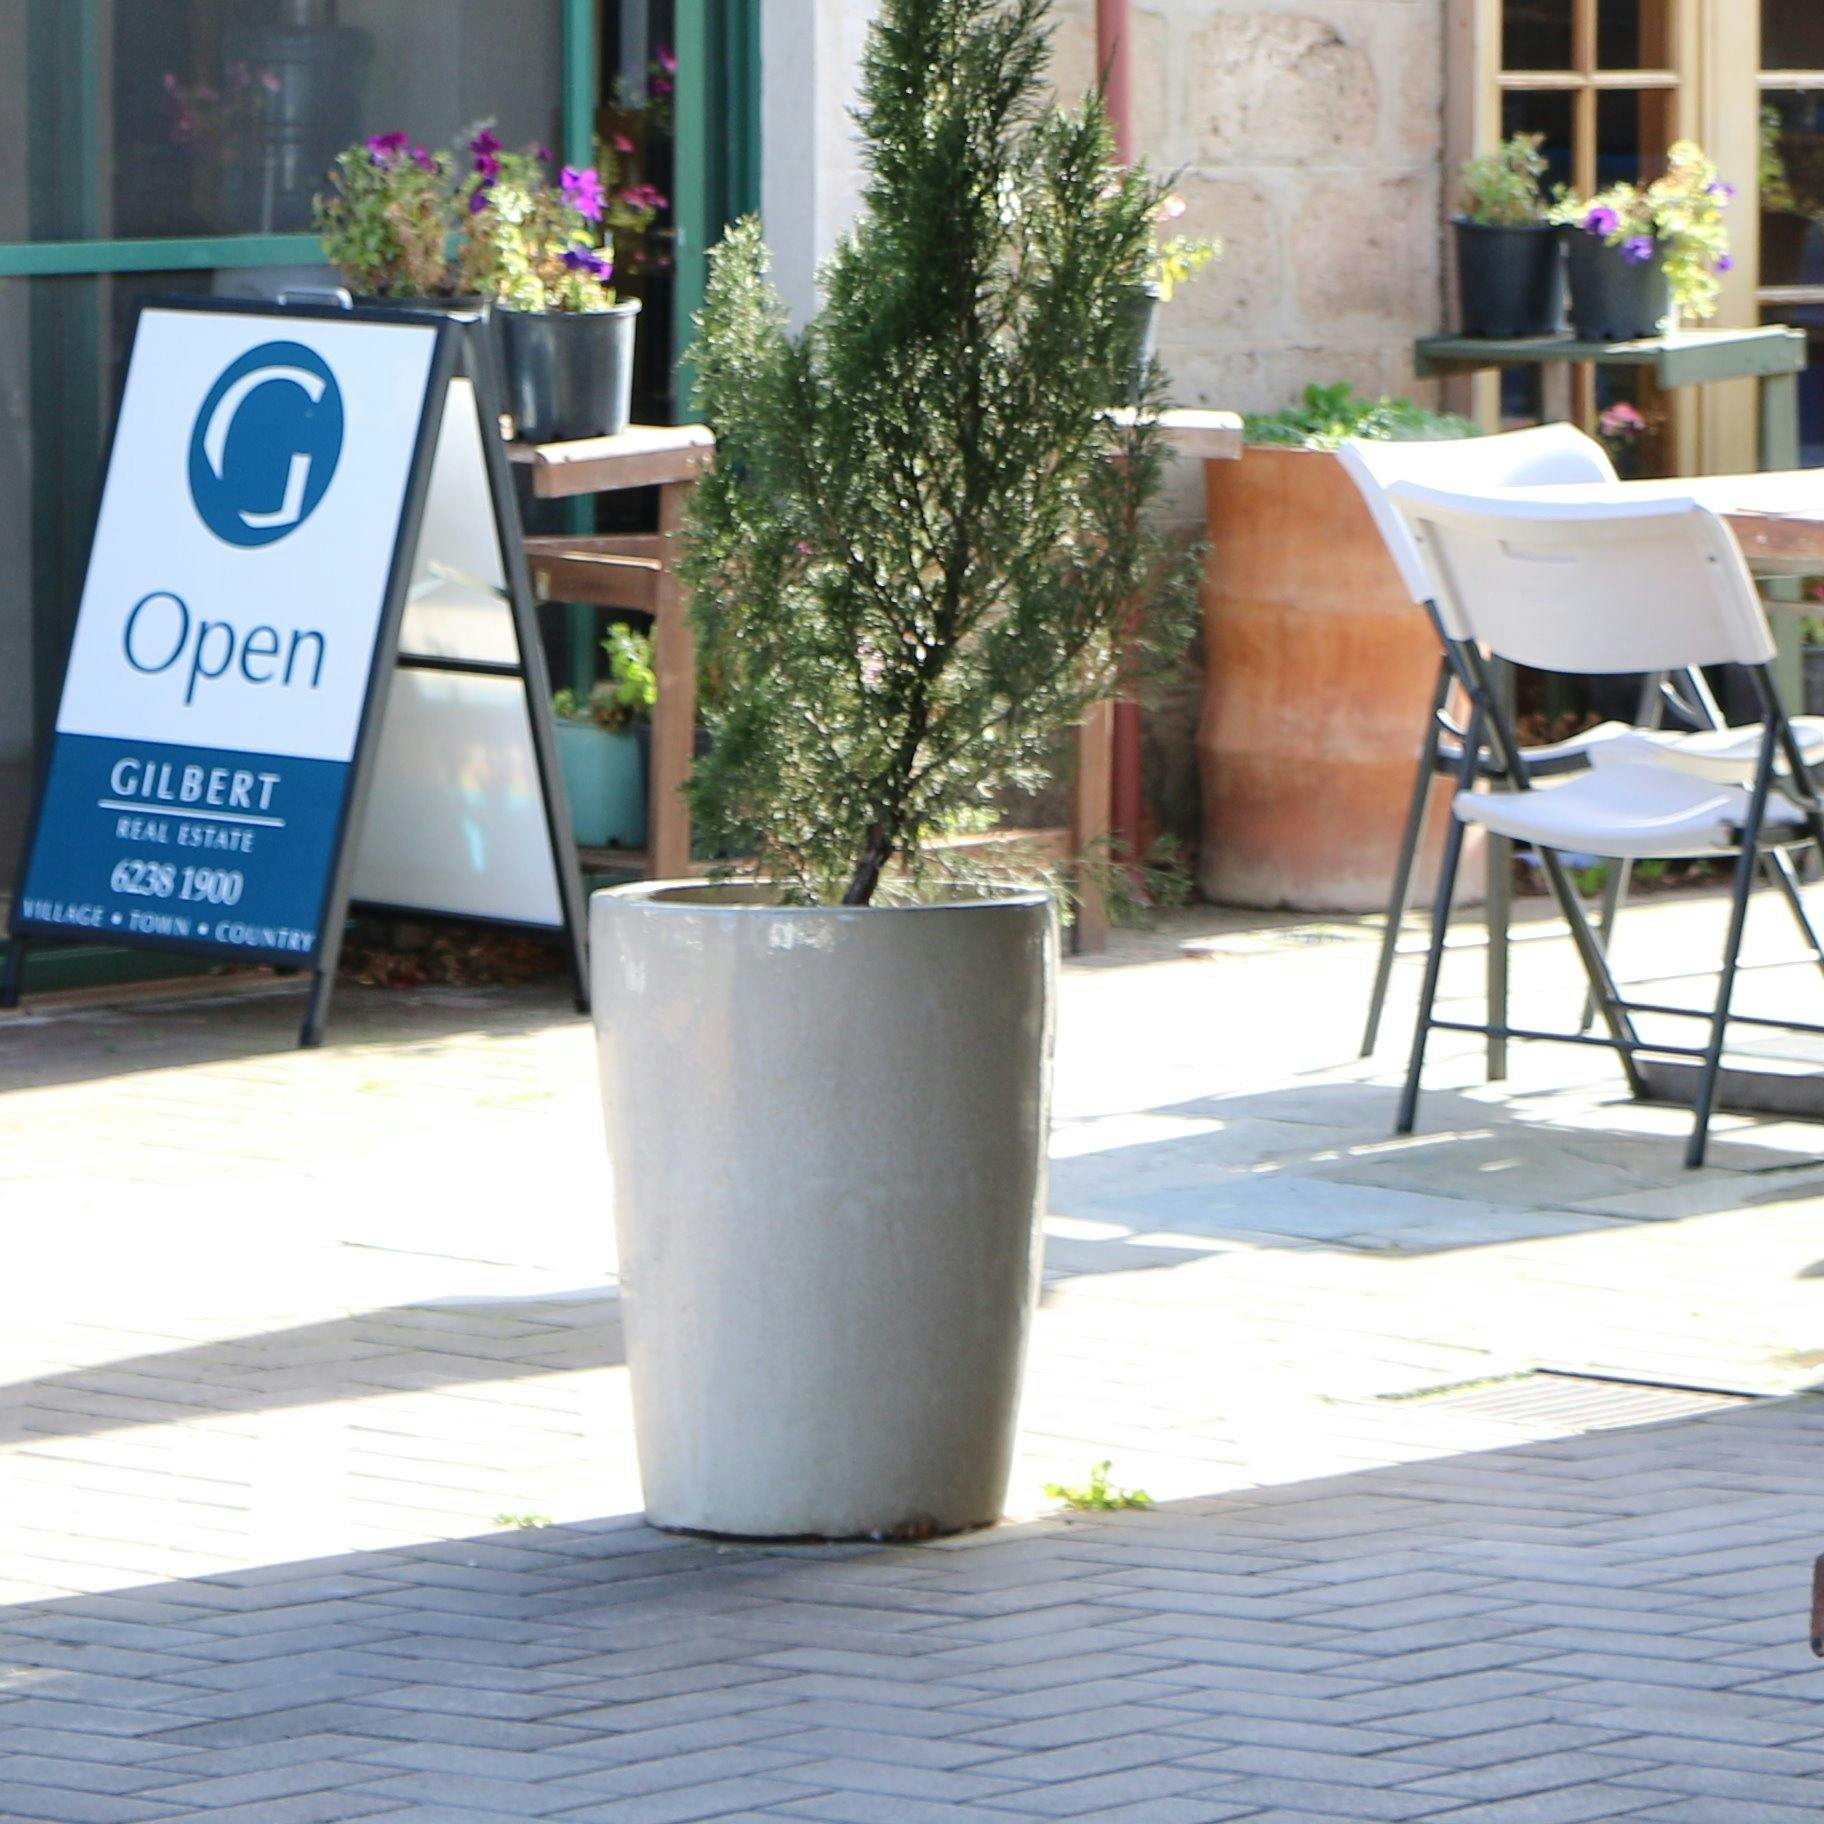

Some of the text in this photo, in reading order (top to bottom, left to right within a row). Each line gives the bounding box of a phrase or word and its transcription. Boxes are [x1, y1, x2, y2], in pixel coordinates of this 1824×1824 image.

[122, 591, 326, 705] Open
[110, 757, 281, 810] GILBERT
[115, 816, 256, 853] REAL ESTATE
[110, 858, 244, 906] 6238 1900
[23, 897, 316, 953] VILLAGE TOWN COUNTRY
